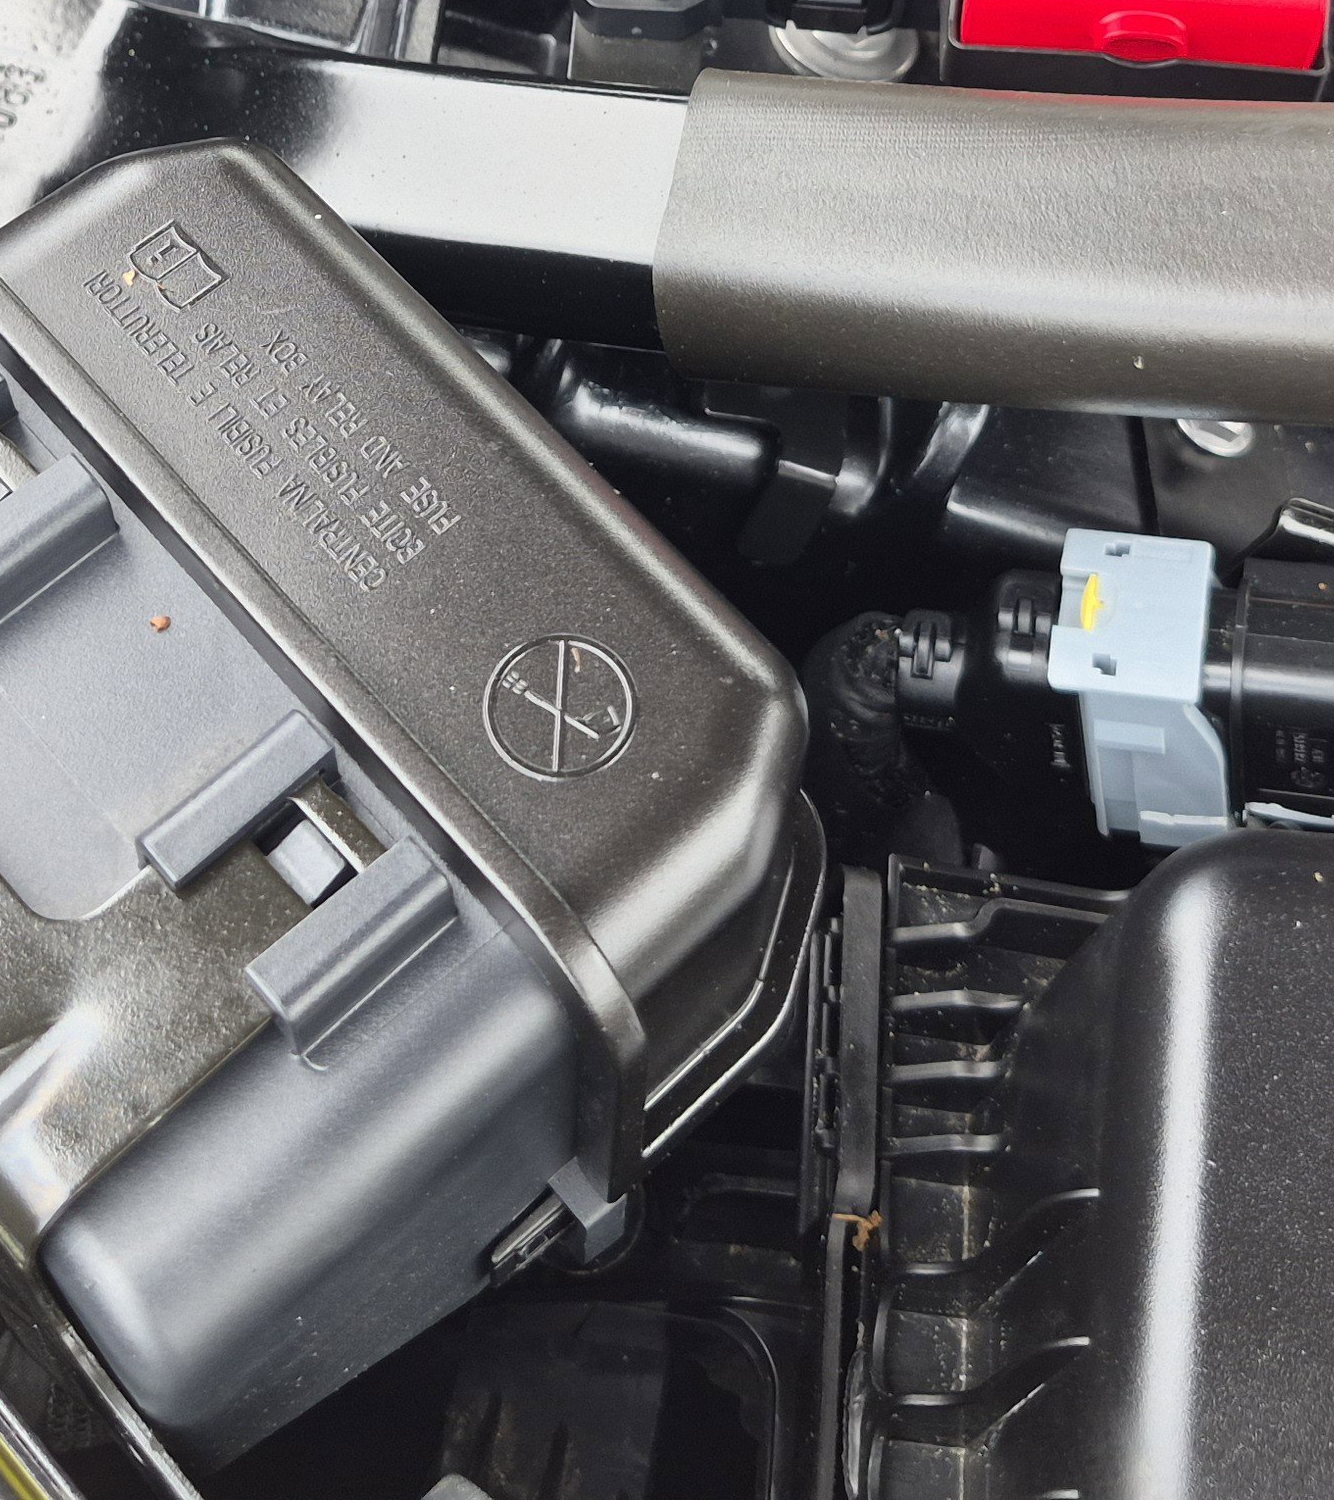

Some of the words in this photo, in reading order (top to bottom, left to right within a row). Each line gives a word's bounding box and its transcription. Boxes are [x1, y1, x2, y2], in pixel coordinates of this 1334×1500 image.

[80, 265, 199, 387] TELERUTTORI
[188, 317, 261, 391] RELAIS
[259, 327, 311, 379] BOX
[187, 378, 219, 409] E
[250, 382, 291, 423] ET
[299, 369, 370, 441] RELAY
[204, 398, 286, 481] FUSIBILI
[279, 411, 375, 509] FUSIBLES
[357, 430, 412, 485] AND
[270, 471, 394, 596] CENTRALINA
[358, 496, 429, 568] BOITE
[400, 474, 464, 539] FUSE
